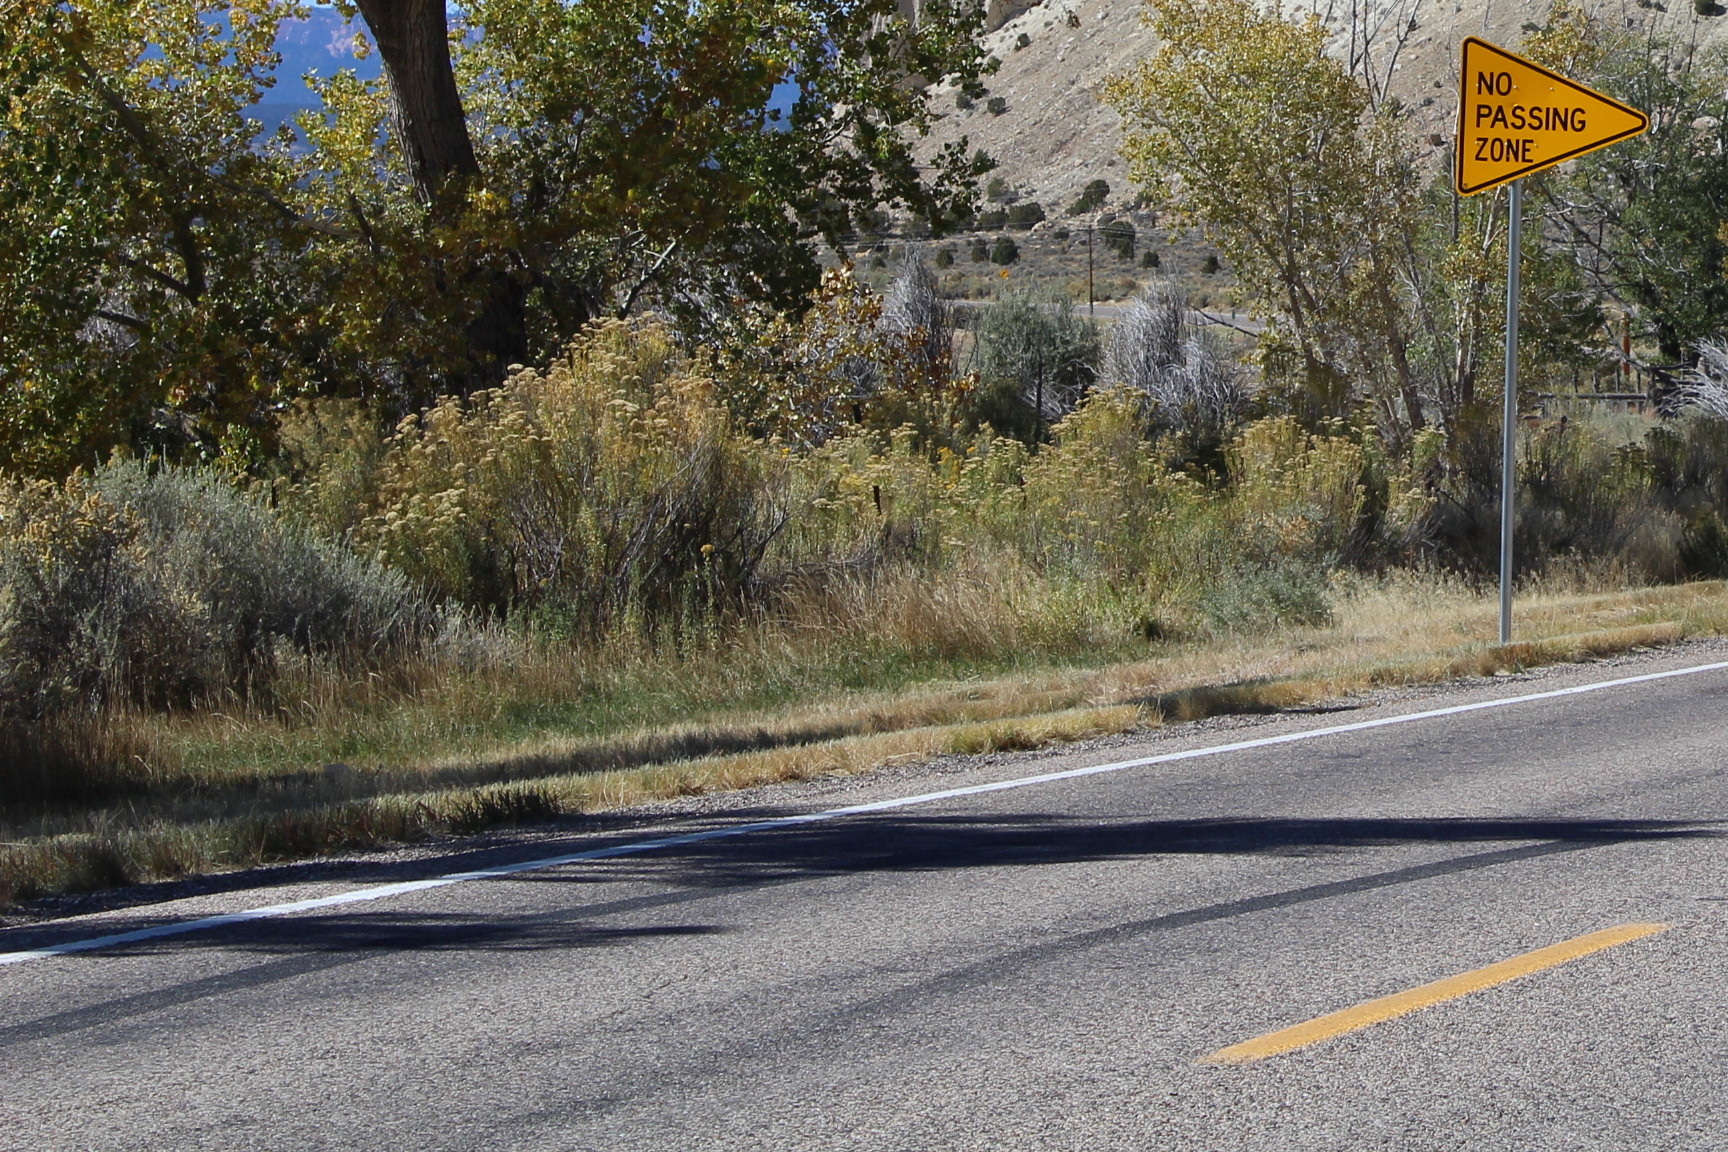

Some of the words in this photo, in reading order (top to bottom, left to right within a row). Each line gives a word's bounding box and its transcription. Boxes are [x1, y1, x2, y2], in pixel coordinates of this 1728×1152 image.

[1477, 71, 1513, 96] NO
[1475, 104, 1587, 133] PASSING
[1474, 137, 1535, 163] ZONE
